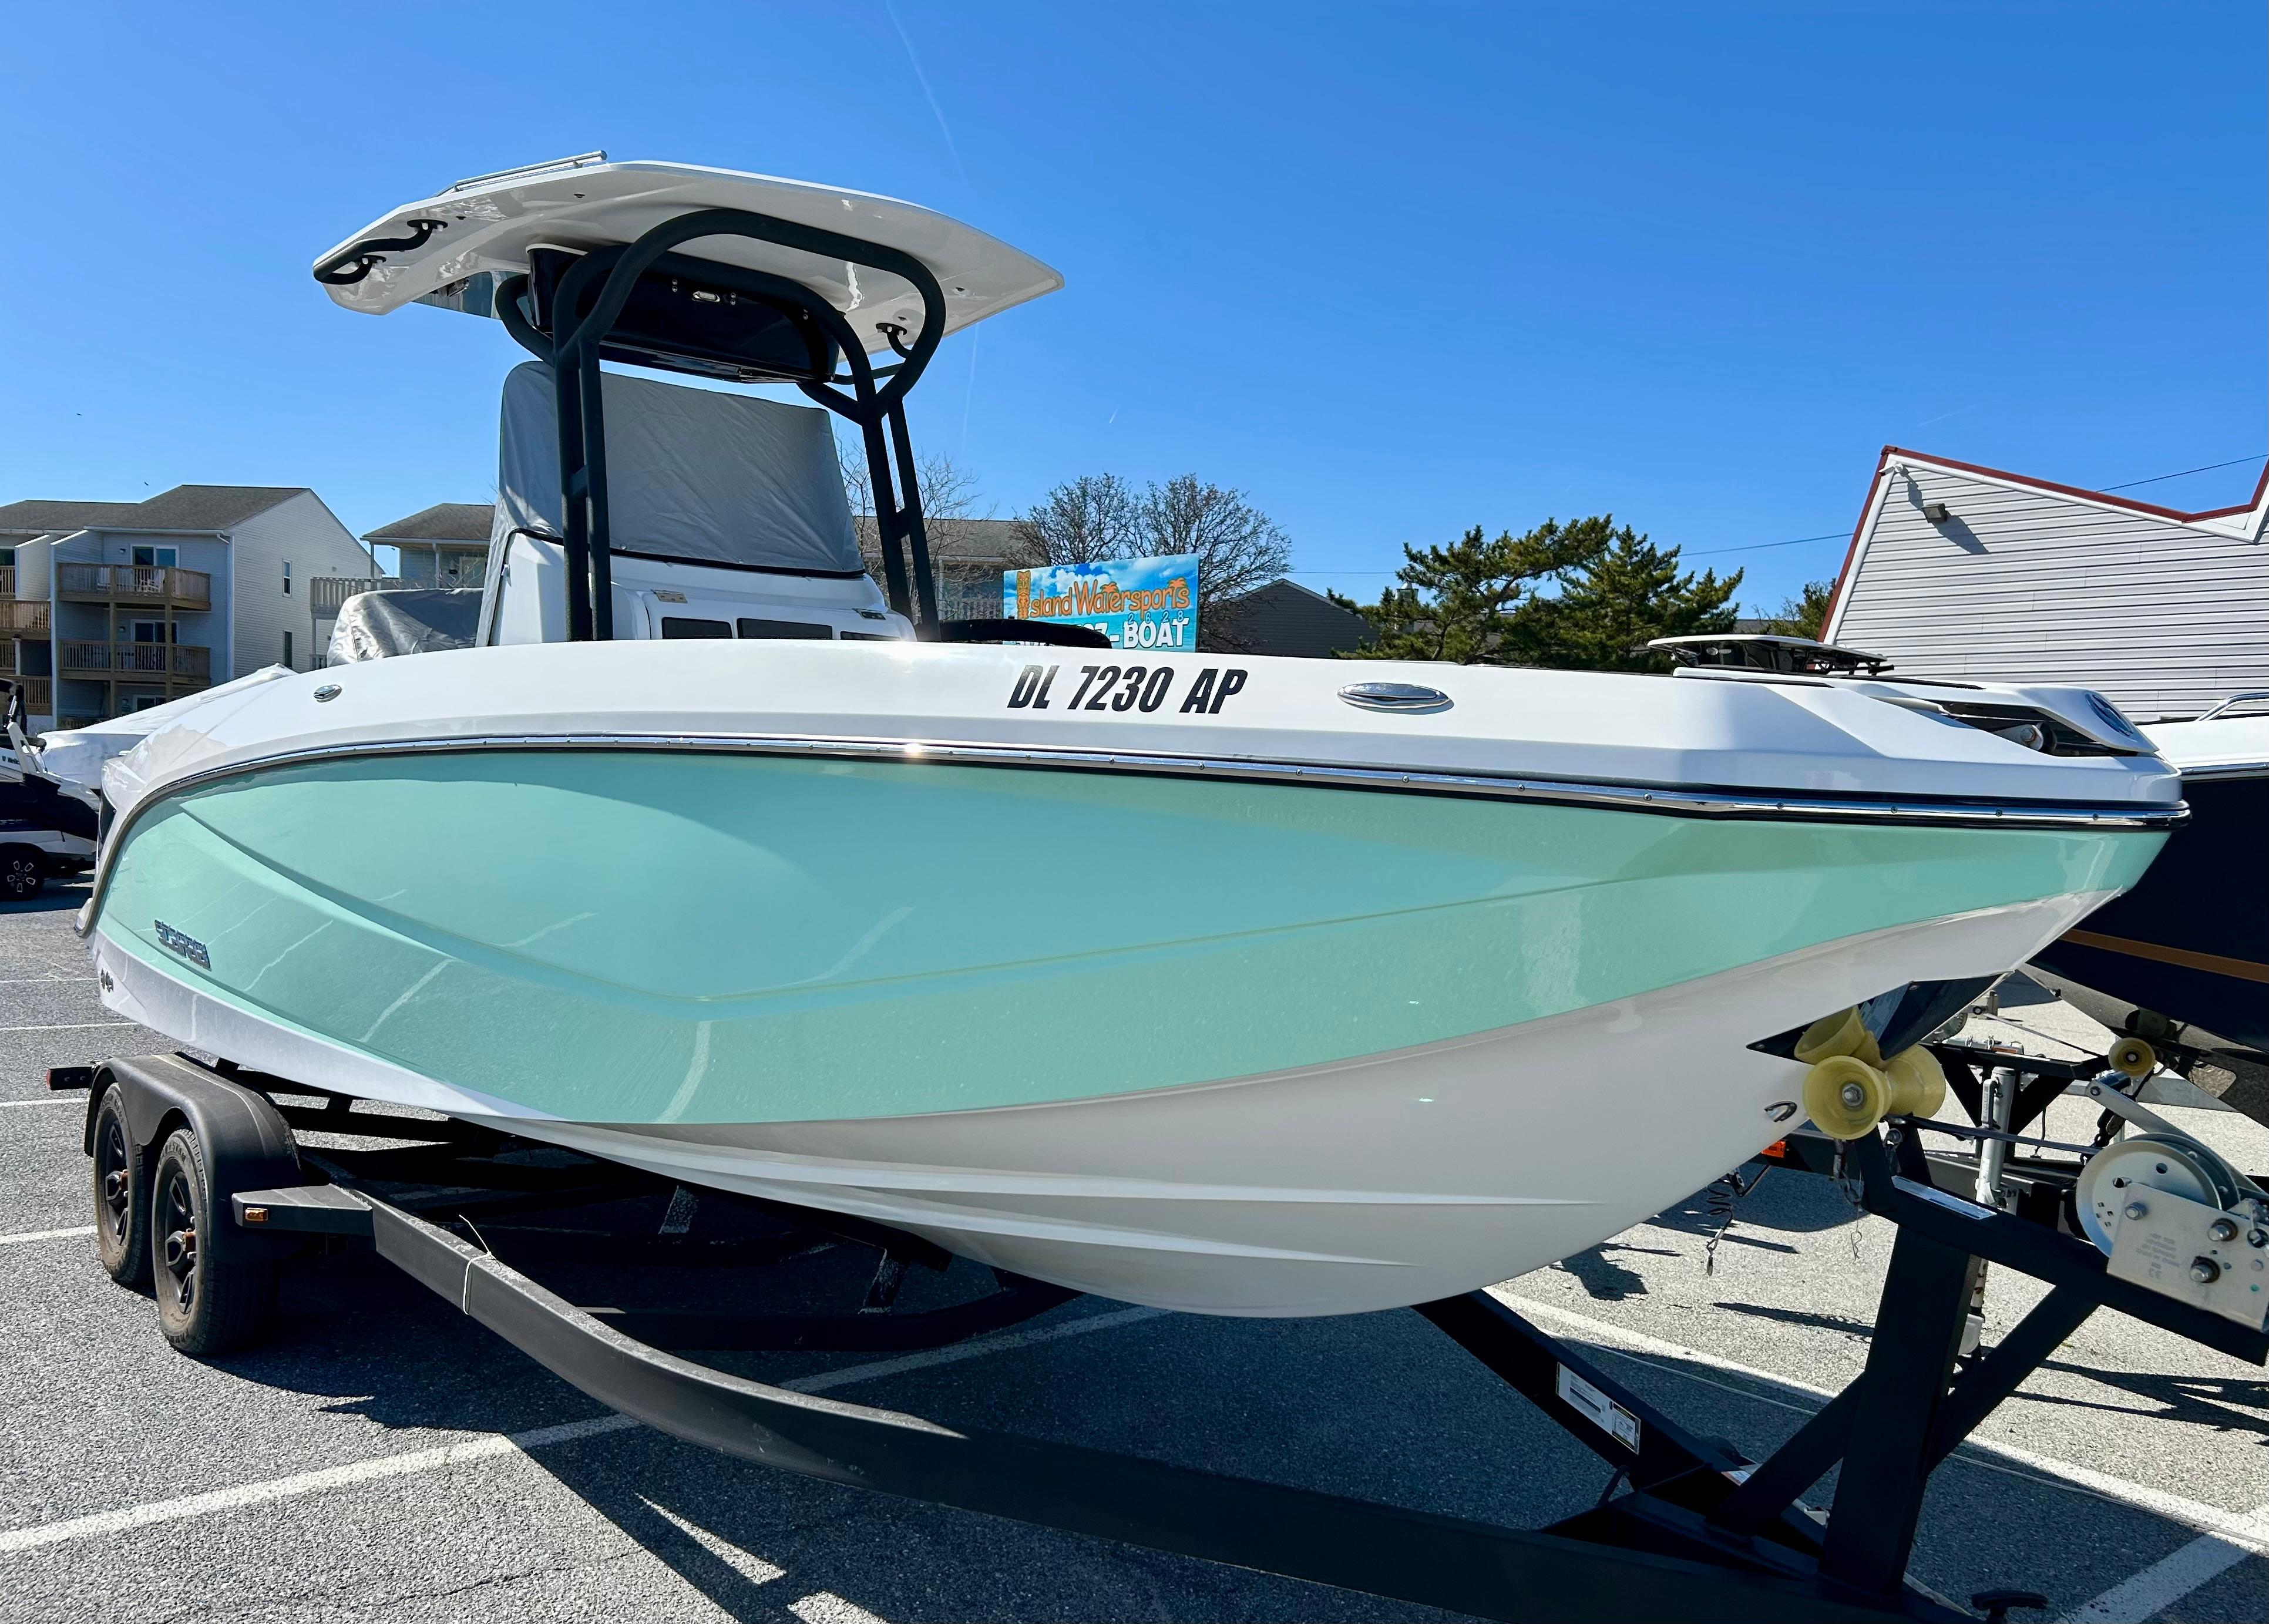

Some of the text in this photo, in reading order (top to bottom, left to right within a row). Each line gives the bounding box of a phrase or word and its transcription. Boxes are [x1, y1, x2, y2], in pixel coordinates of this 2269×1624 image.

[1017, 570, 1189, 620] Island Watersports
[1007, 664, 1248, 714] DL 7230 AP
